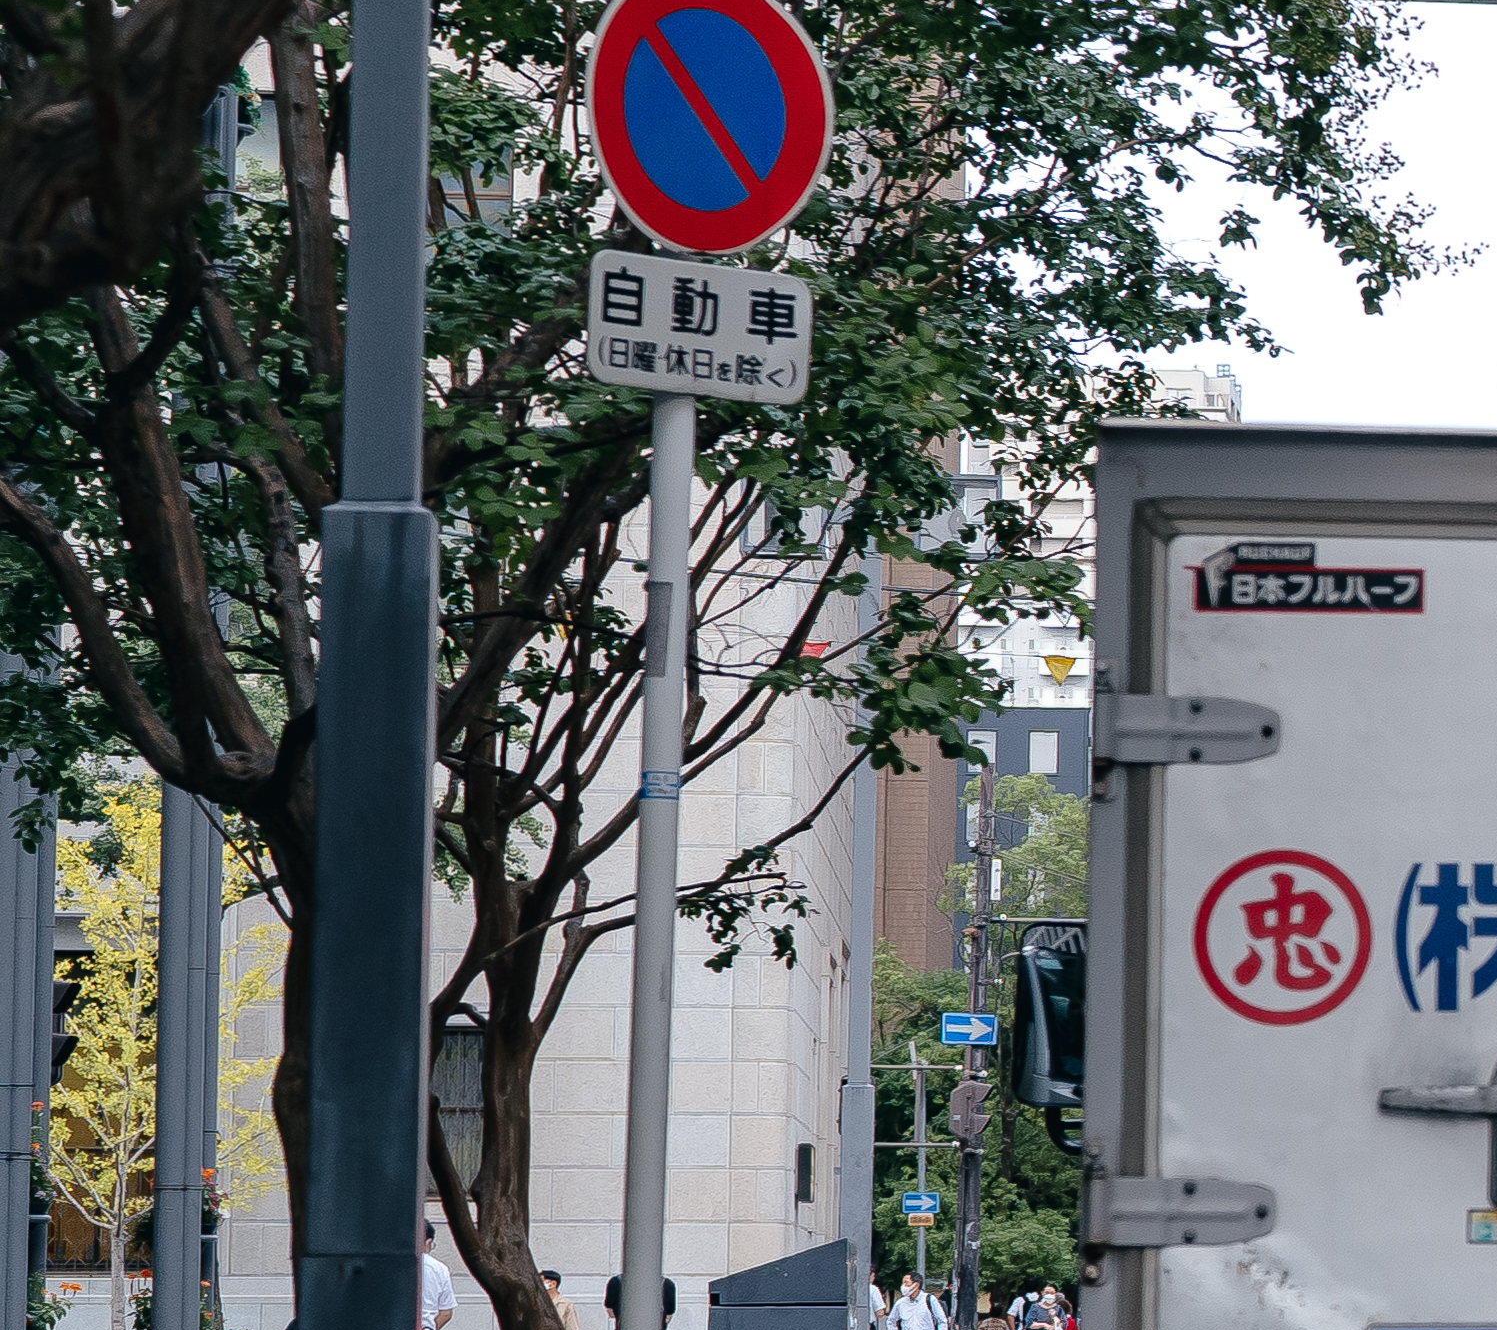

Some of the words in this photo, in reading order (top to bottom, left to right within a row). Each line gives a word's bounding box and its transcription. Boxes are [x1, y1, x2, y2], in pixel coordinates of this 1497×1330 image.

[602, 266, 798, 345] 自動車
[1231, 573, 1420, 609] 日本フルハーフ
[1233, 872, 1342, 990] 忠
